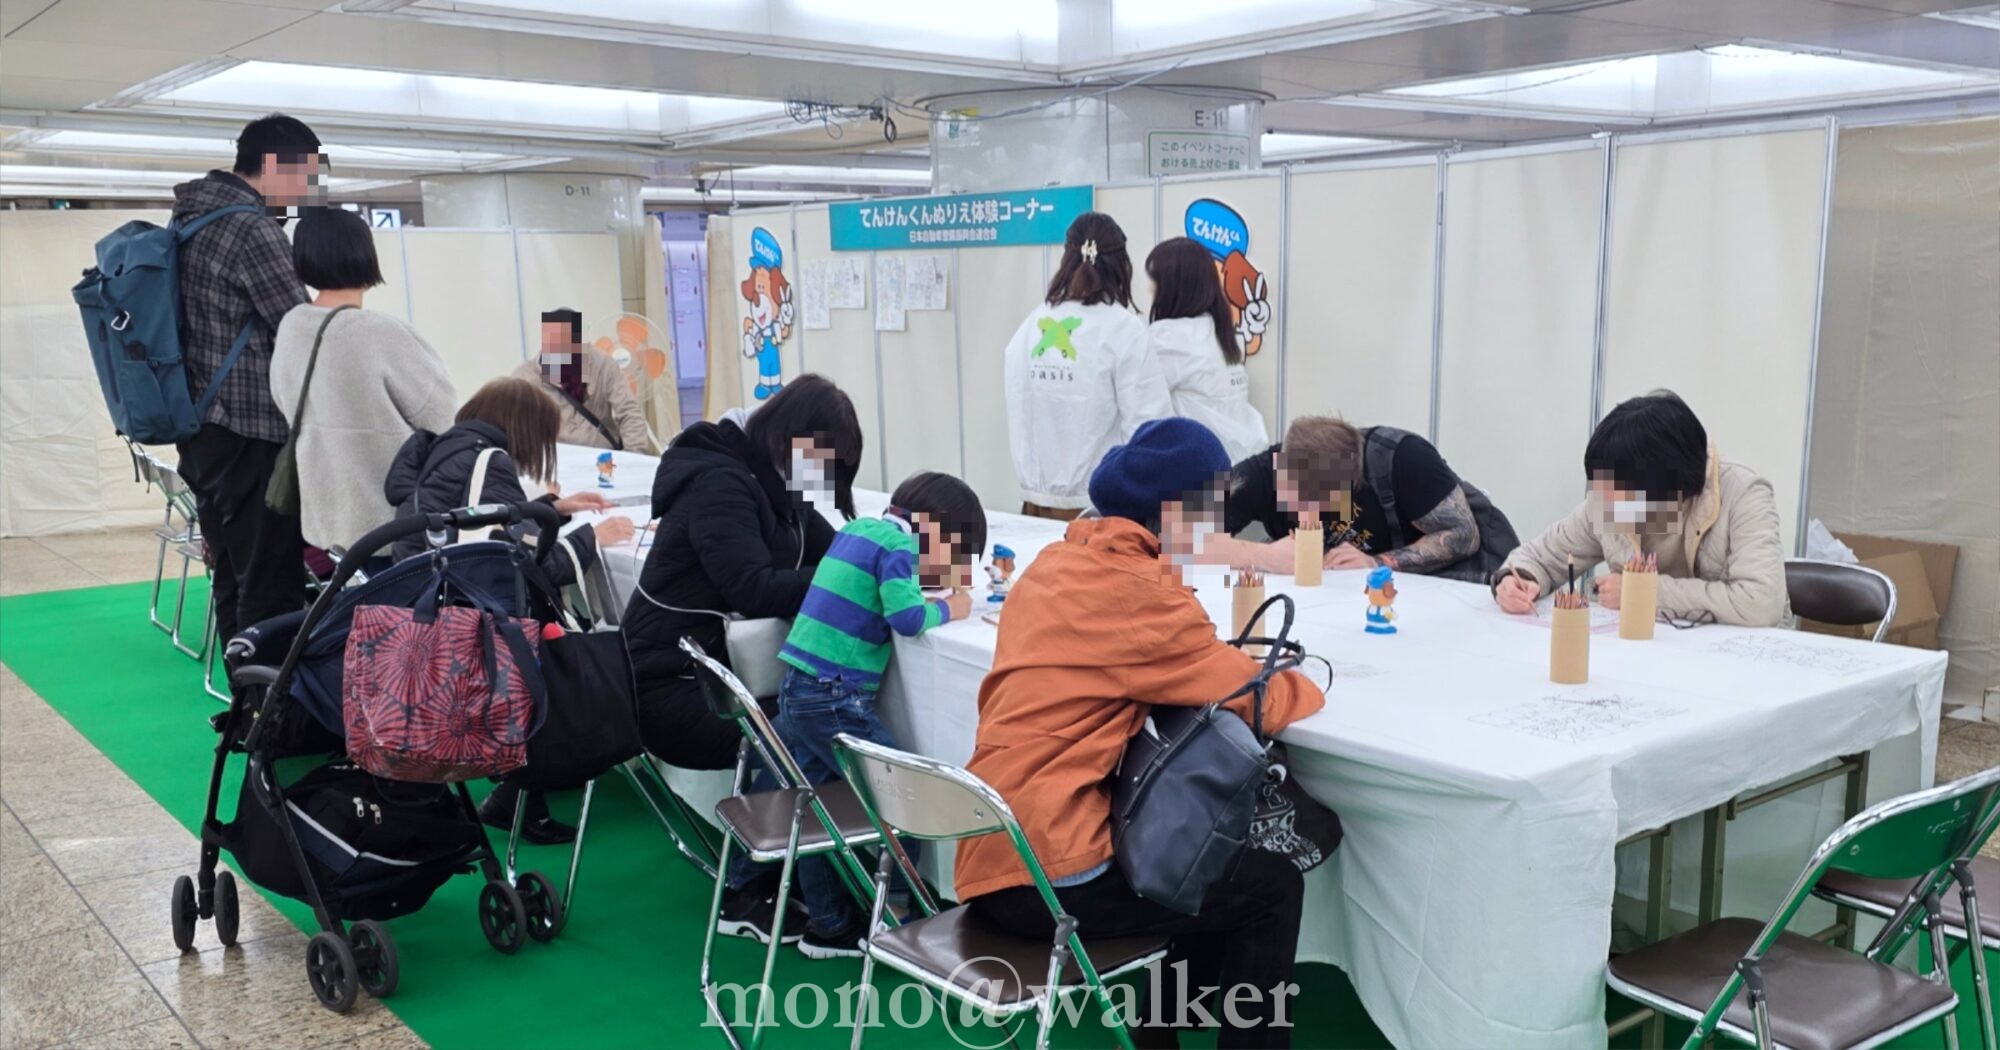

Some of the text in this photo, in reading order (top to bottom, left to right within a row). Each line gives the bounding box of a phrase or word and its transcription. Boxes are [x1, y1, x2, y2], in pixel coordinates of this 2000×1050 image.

[860, 197, 1055, 228] てんけんくんぬりえ体験コーナー
